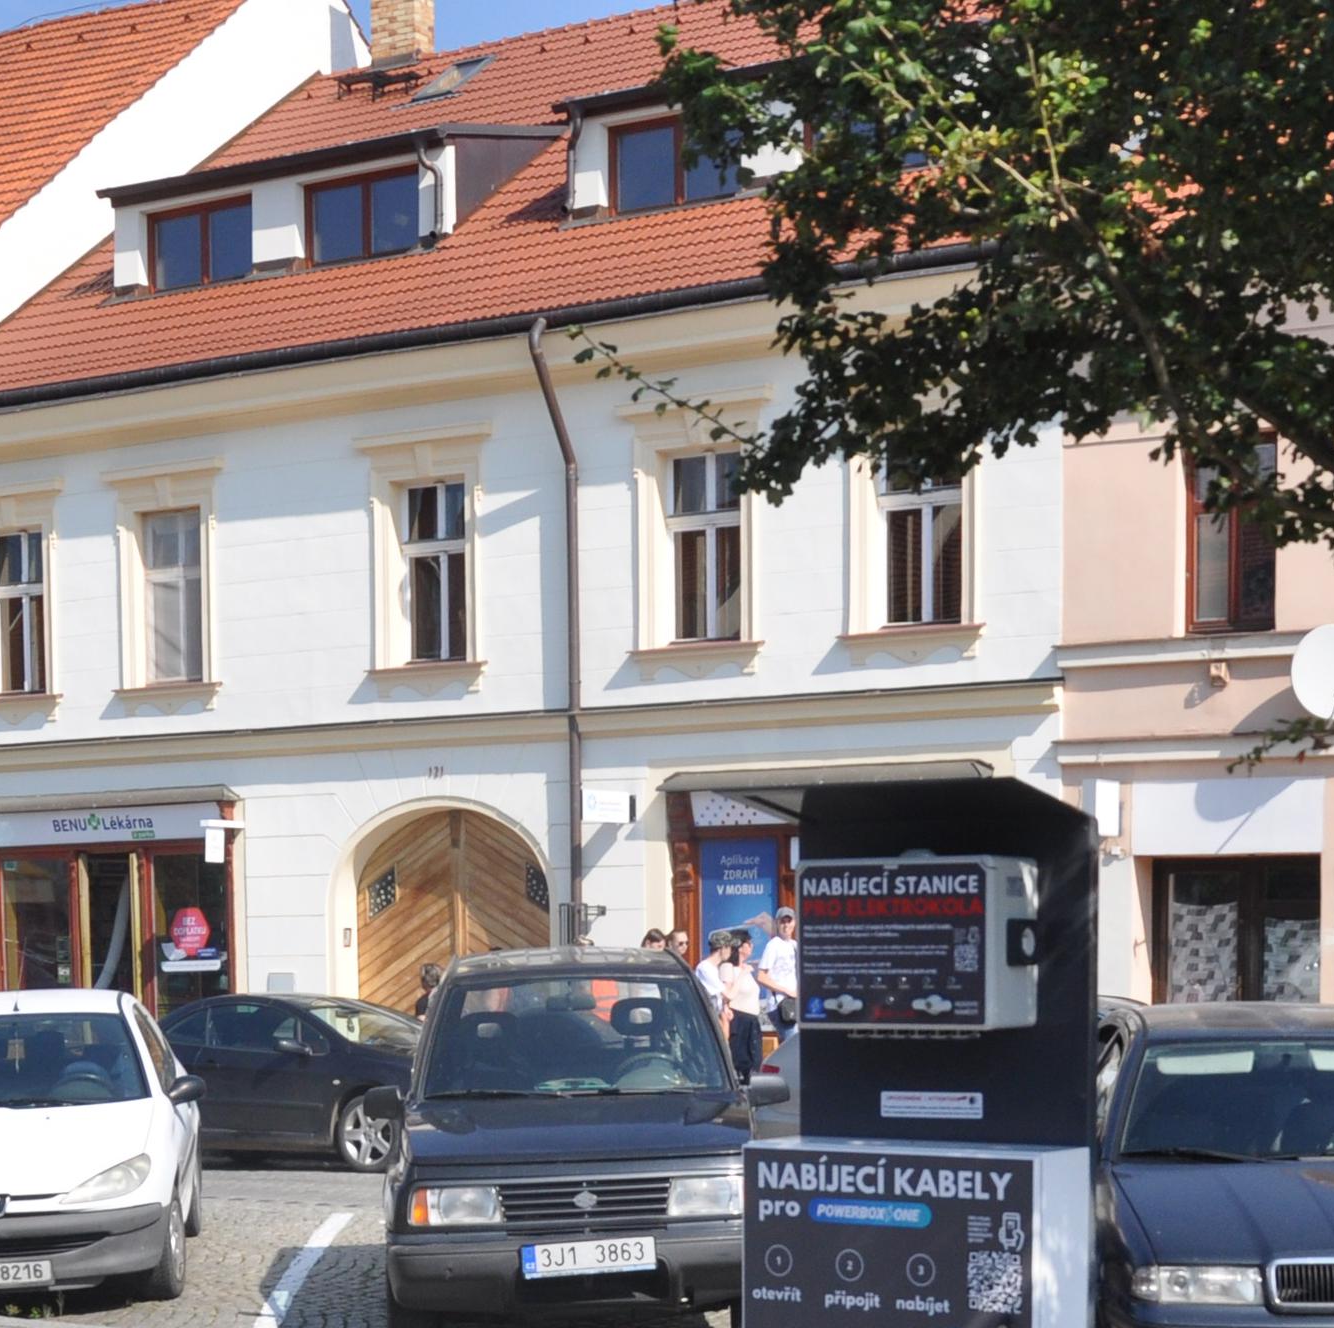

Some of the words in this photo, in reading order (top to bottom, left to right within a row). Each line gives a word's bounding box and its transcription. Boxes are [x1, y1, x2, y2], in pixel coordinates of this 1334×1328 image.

[52, 819, 88, 833] BENU
[101, 815, 154, 831] Lékárna
[720, 854, 760, 866] Aplikace
[723, 867, 758, 880] ZDRAVÍ
[716, 885, 725, 896] V
[726, 884, 764, 896] MOBILU
[803, 871, 888, 896] NABÍJECÍ
[894, 874, 979, 895] STANICE
[803, 899, 842, 917] PRO
[846, 896, 983, 917] ELEKTROKOLA
[757, 1155, 887, 1195] NABÍJECÍ
[894, 1167, 1013, 1201] KABELY
[758, 1198, 801, 1222] pro
[816, 1204, 885, 1221] POWERBOX
[893, 1207, 921, 1222] ONE
[540, 1246, 577, 1268] 3J1
[595, 1241, 645, 1264] 3863
[0, 1263, 43, 1281] 8216
[752, 1286, 802, 1303] otevřít
[824, 1292, 881, 1311] připojit
[896, 1296, 950, 1316] nabíjet
